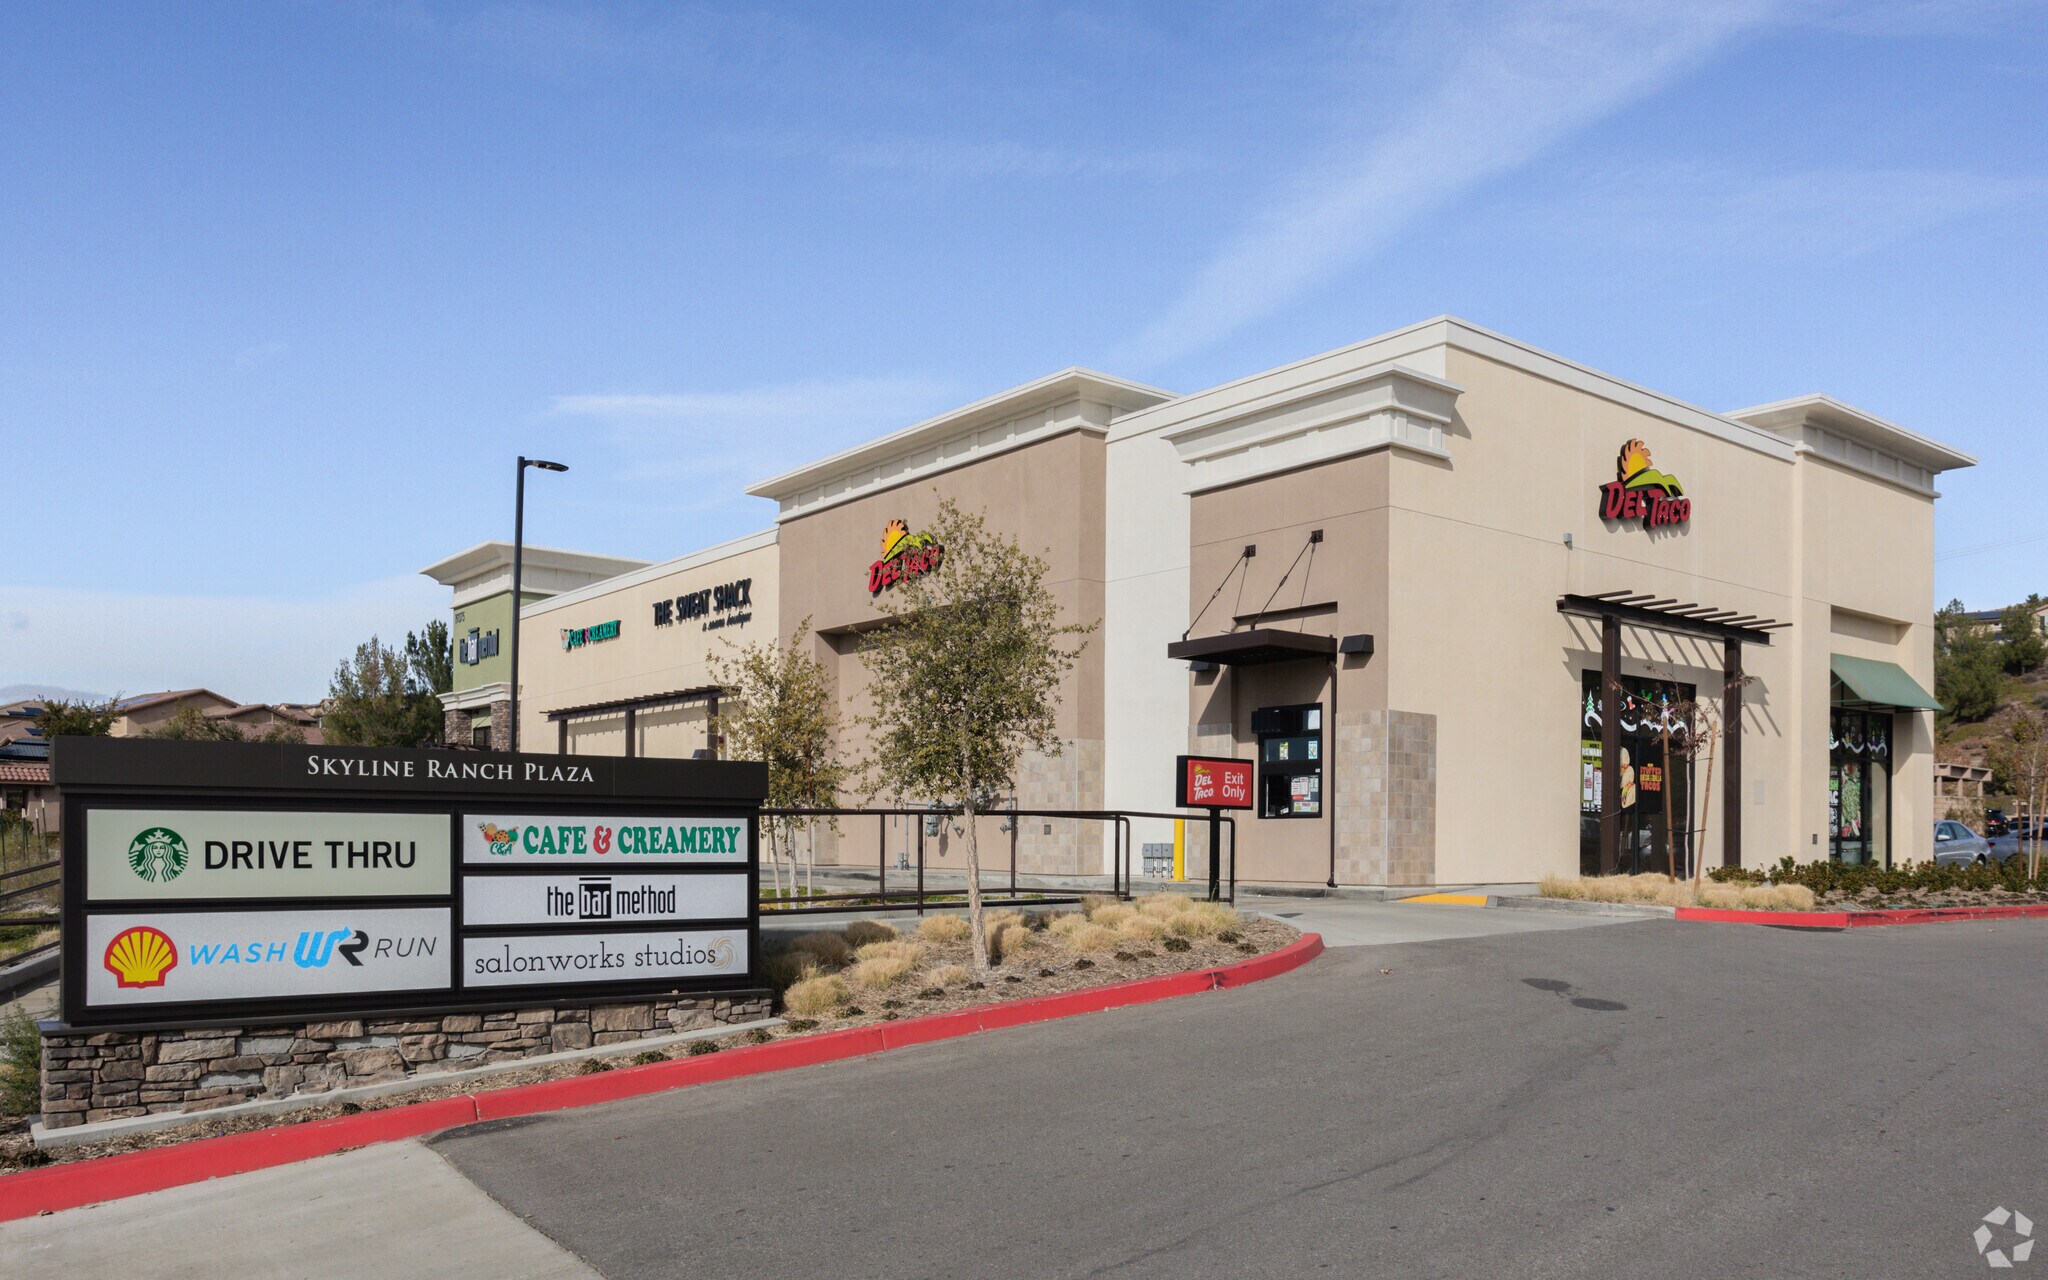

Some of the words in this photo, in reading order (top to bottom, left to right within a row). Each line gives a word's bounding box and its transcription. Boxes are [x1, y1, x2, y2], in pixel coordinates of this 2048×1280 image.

[1603, 481, 1648, 519] DEL
[1646, 489, 1691, 528] TACO
[868, 559, 901, 592] DEL
[652, 599, 673, 627] THE
[676, 589, 712, 623] SWEAT
[713, 578, 752, 612] SHACK
[569, 629, 584, 646] CAFE
[589, 620, 620, 641] CREAMERY
[307, 755, 414, 778] SKYLINE
[427, 759, 513, 781] RANCH
[524, 762, 595, 783] PLAZA
[1194, 774, 1213, 787] DEL
[1224, 771, 1244, 785] Exit
[1194, 787, 1214, 800] TACO
[1222, 785, 1245, 801] Only
[523, 825, 587, 854] CAFE
[593, 825, 612, 854] &
[617, 826, 741, 854] CREAMERY
[204, 841, 313, 869] DRIVE
[324, 841, 416, 868] THRU
[547, 886, 574, 916] the
[580, 884, 610, 917] bar
[616, 885, 676, 914] method
[190, 942, 287, 965] WASH
[374, 937, 438, 958] RUN
[475, 941, 625, 974] salonworks
[634, 938, 716, 967] studios
